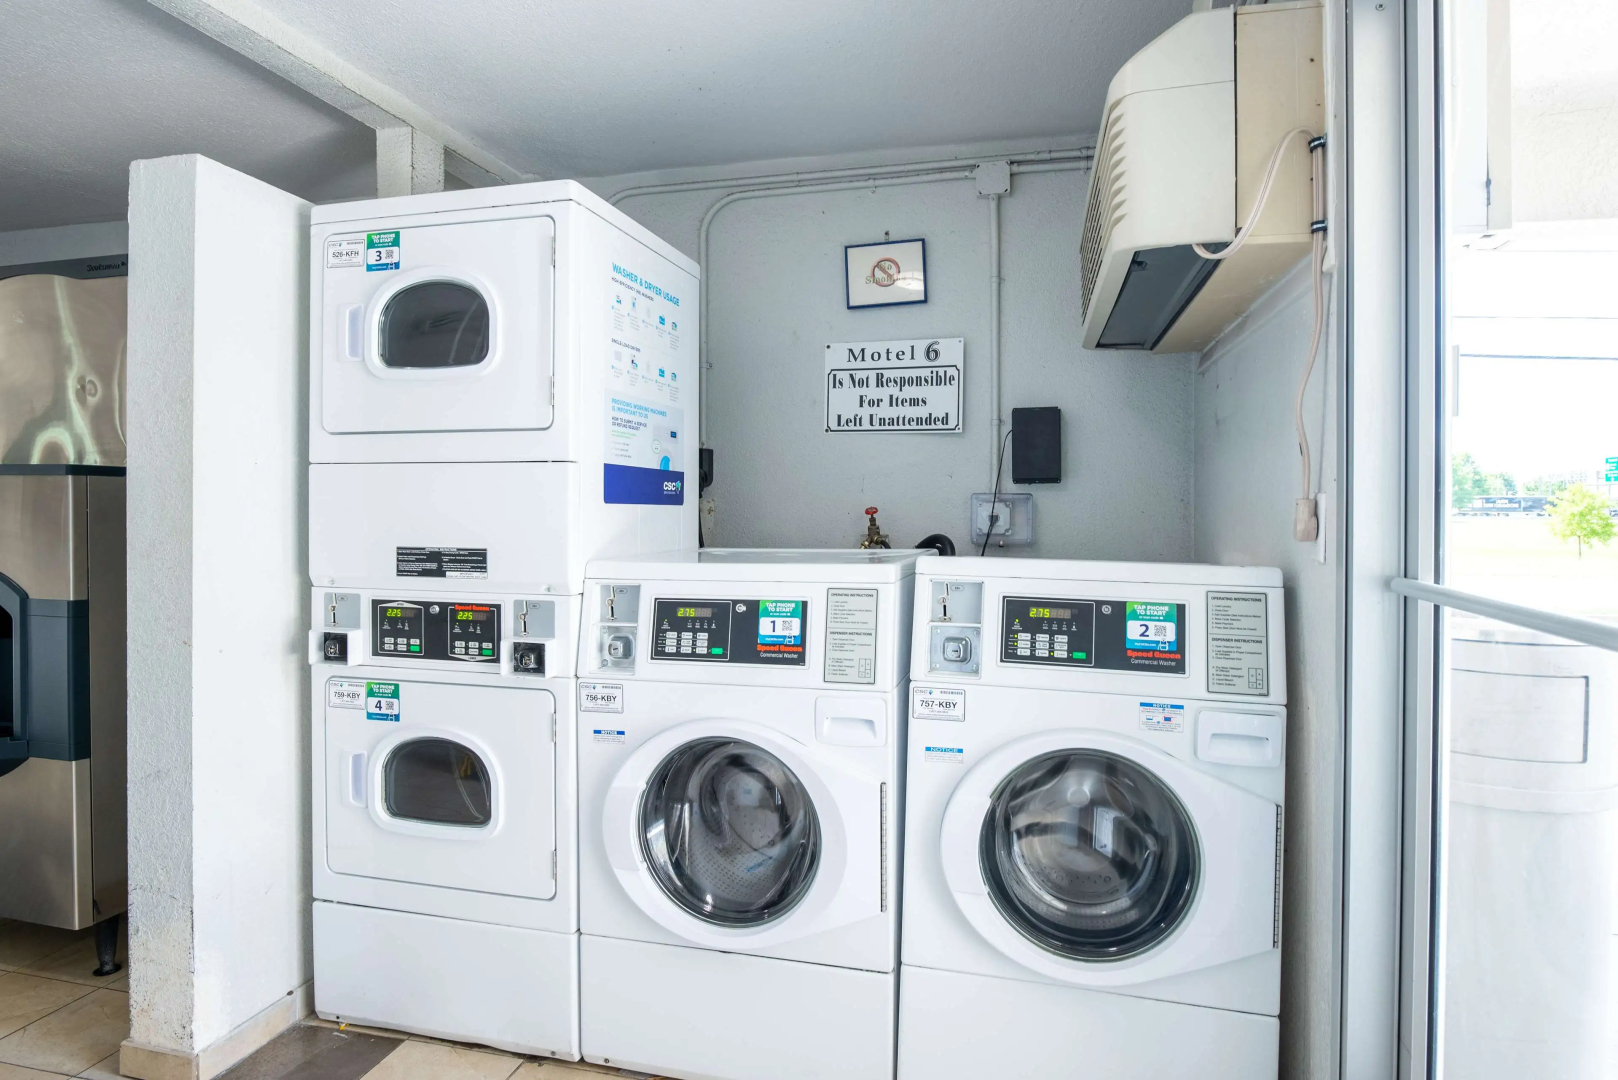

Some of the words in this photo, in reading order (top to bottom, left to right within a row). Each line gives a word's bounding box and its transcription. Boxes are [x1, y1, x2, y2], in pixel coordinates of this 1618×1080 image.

[375, 250, 382, 261] 3
[612, 262, 638, 284] WASHER
[640, 278, 643, 286] &
[645, 280, 662, 297] DRYER
[663, 290, 680, 306] USAGE
[847, 345, 916, 362] Motel
[924, 341, 940, 362] 6
[832, 373, 844, 389] Is
[848, 373, 870, 388] Not
[875, 370, 956, 392] Responsible
[859, 394, 883, 408] For
[888, 394, 927, 408] Items
[612, 398, 632, 408] PROVIDING
[634, 403, 649, 412] WORKING
[650, 407, 667, 417] MACHINES
[616, 407, 637, 416] IMPORTANT
[836, 414, 863, 428] Left
[869, 412, 949, 427] Unattended
[664, 482, 676, 490] CSC
[677, 608, 695, 617] 2.75
[1030, 609, 1049, 618] 2.75
[770, 620, 775, 632] 1
[1139, 624, 1149, 637] 2
[1127, 650, 1153, 658] Speed
[375, 700, 382, 711] 4
[920, 700, 957, 709] 757-KBY
